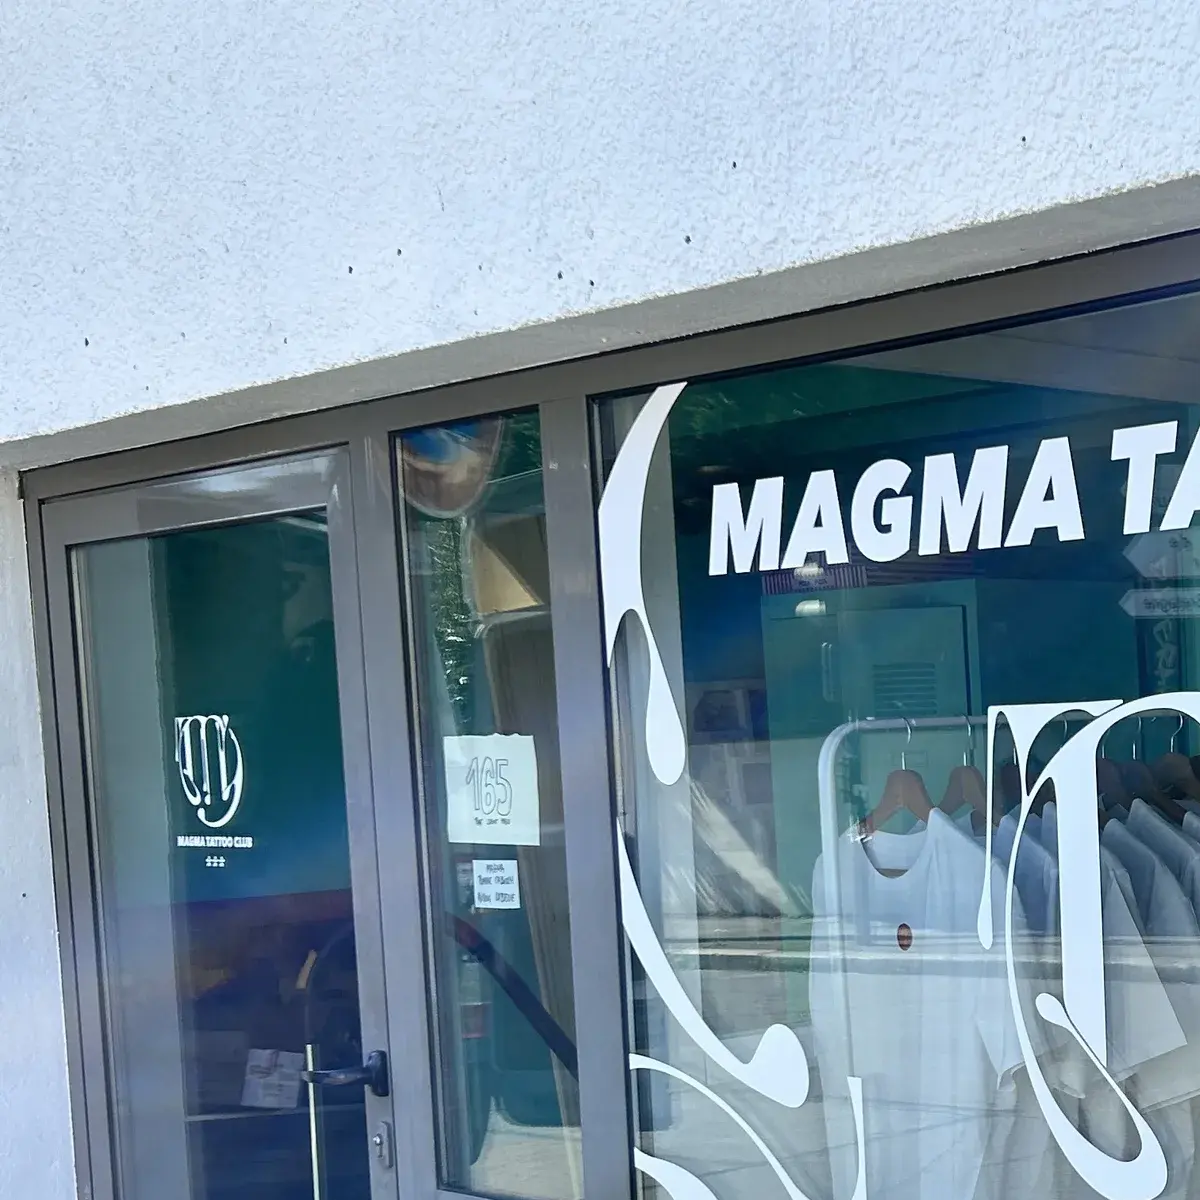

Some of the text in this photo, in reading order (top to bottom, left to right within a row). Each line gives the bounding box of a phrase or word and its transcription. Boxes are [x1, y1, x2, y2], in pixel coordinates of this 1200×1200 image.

[708, 437, 1085, 577] MAGMA
[466, 756, 513, 816] 165
[177, 836, 253, 848] MAGMA TATTOO CLUB
